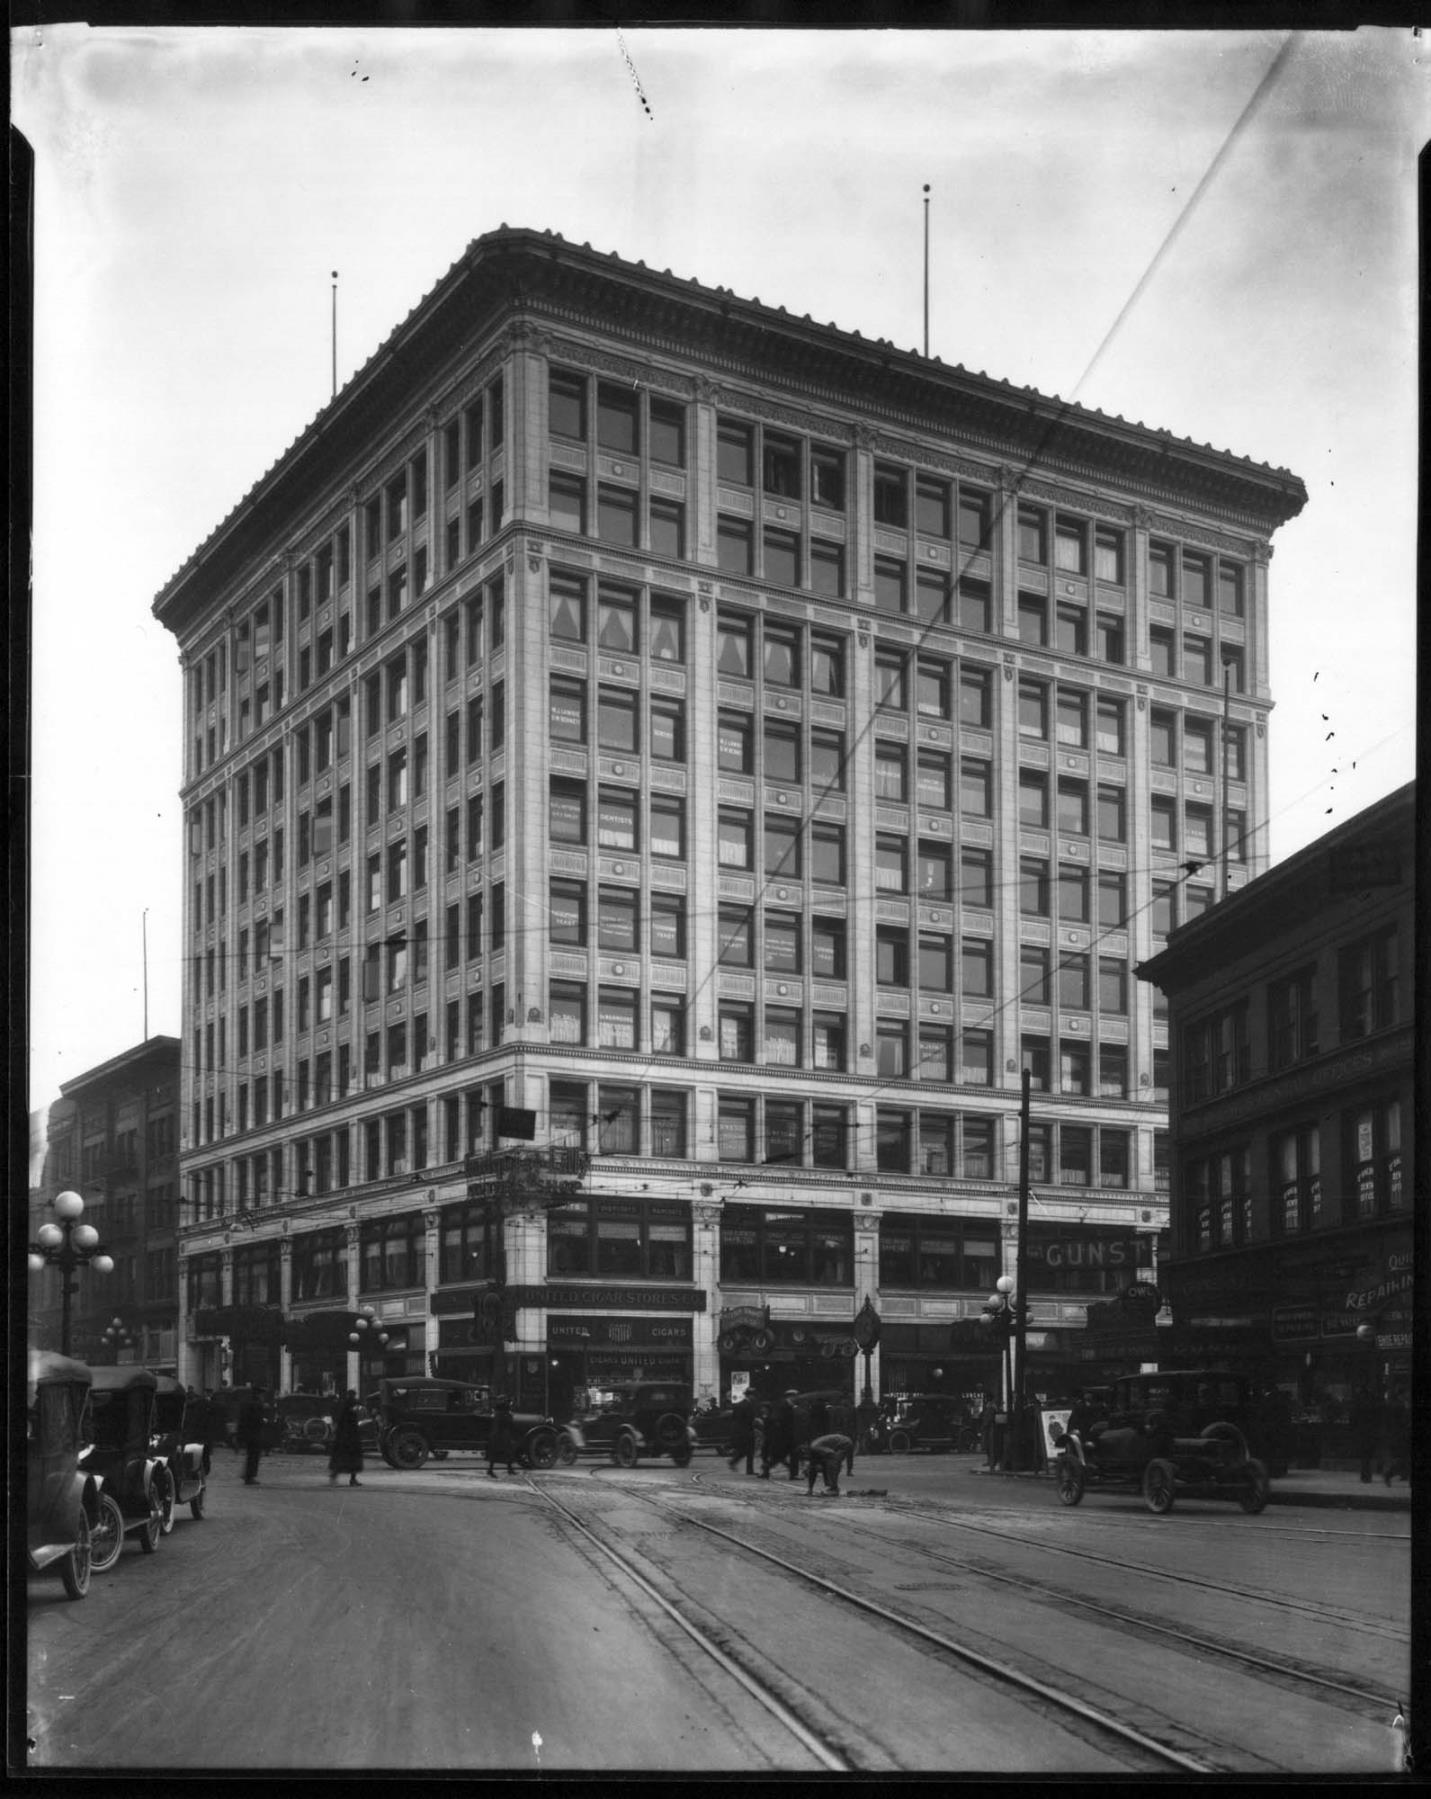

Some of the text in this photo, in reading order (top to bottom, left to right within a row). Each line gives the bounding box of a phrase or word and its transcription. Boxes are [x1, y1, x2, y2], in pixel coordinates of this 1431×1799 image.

[1045, 1240, 1146, 1267] GUNST
[525, 1289, 578, 1303] UNITED
[582, 1291, 623, 1304] CIGAR
[626, 1292, 678, 1305] STORES
[552, 1326, 687, 1337] UNITED CIGARS
